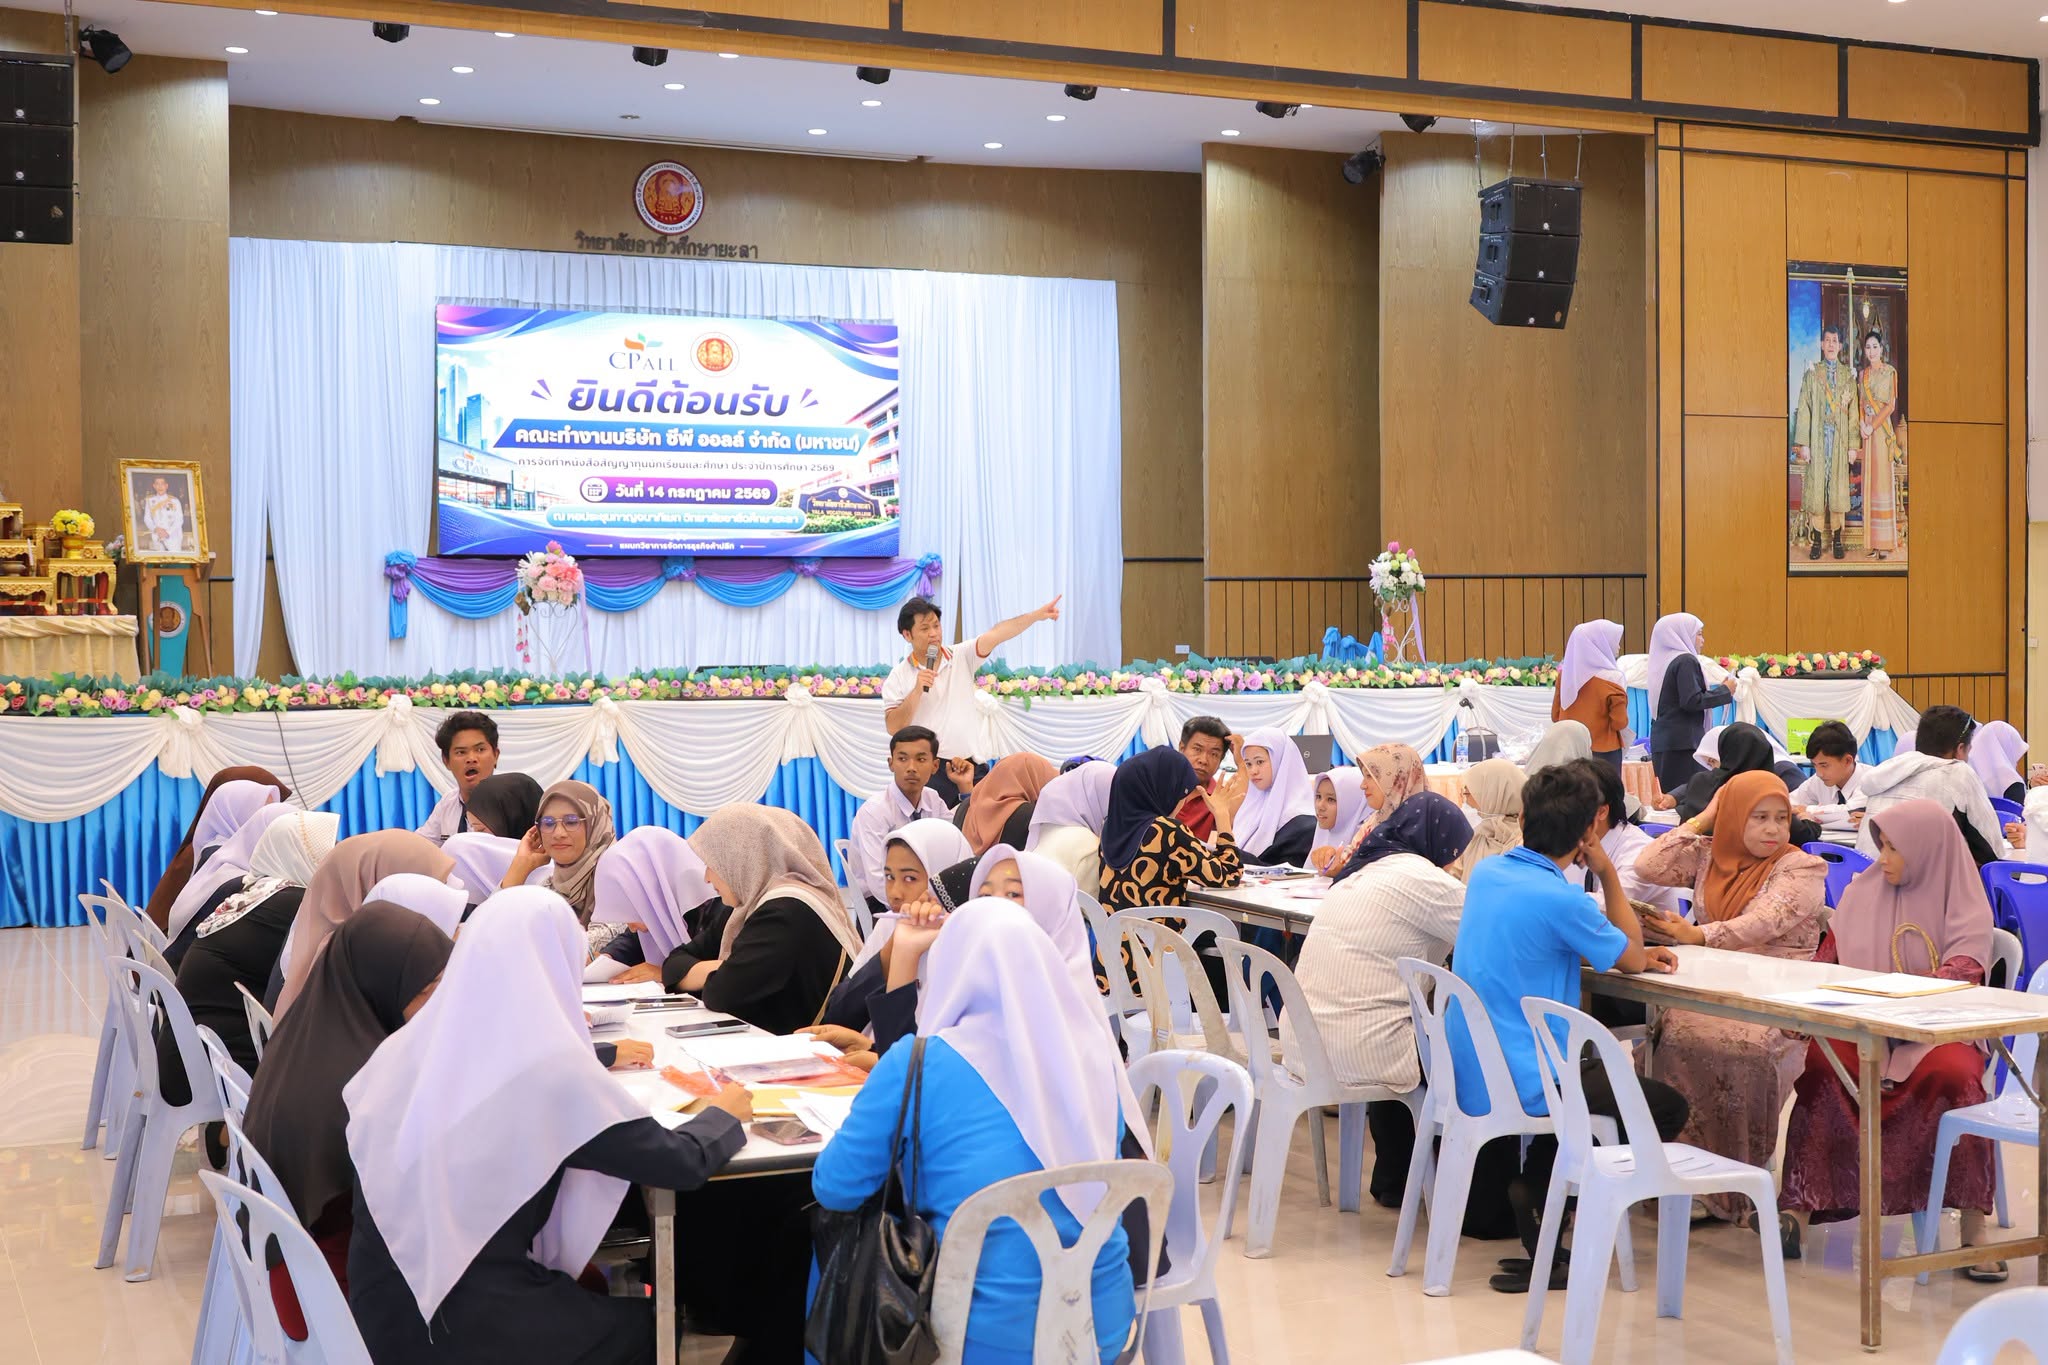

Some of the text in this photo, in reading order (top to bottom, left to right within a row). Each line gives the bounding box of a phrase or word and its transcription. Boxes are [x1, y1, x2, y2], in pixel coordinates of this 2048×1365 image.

[575, 230, 758, 259] วิทยาลัยอาชีวศึกษายะลา
[568, 379, 790, 417] ยินดีต้อนรับ
[515, 425, 860, 452] คณะทำงานบริษัท ซีพี ออลล์ จำกัด (มหาชน)
[811, 464, 835, 472] 2569
[615, 480, 771, 501] วันที่ 14 กรกฎาคม 2569
